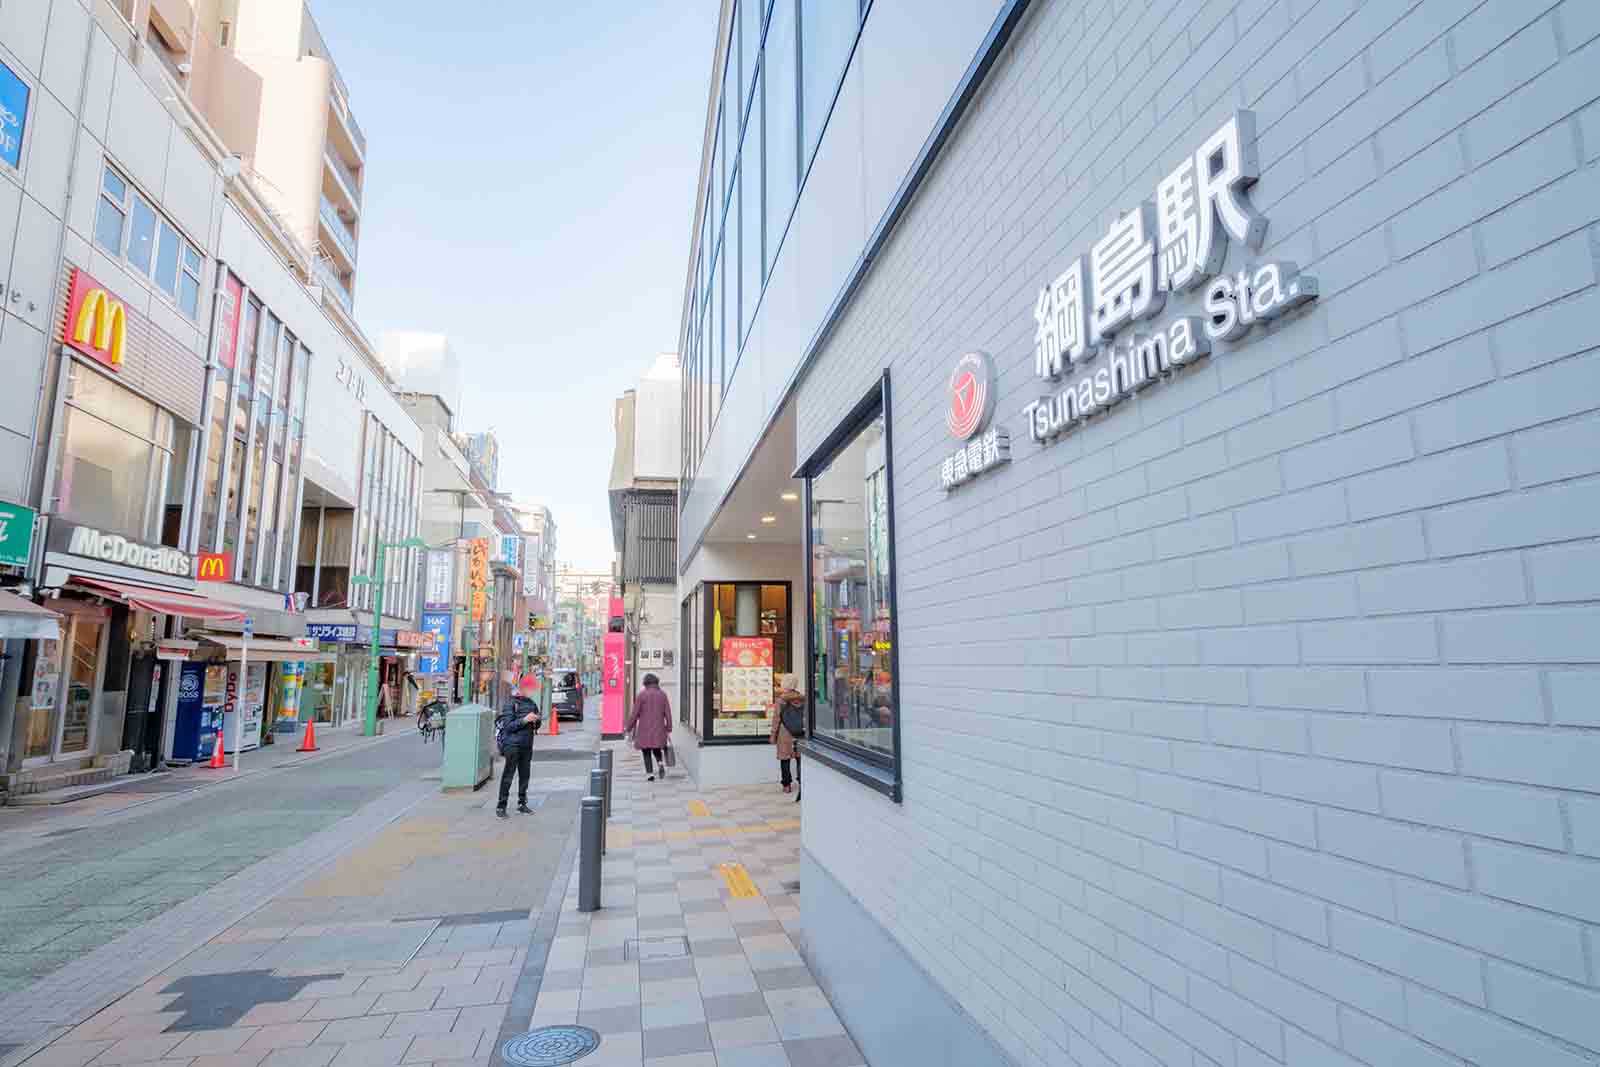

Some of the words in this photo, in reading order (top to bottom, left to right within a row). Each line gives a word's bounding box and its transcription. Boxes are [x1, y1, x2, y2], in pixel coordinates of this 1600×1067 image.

[1034, 112, 1260, 378] 綱島駅
[1023, 318, 1200, 441] Tsunashima
[1203, 262, 1304, 340] Sta.
[941, 427, 1000, 489] 東急電鉄
[70, 526, 191, 576] McDonald's
[427, 616, 446, 625] HAC
